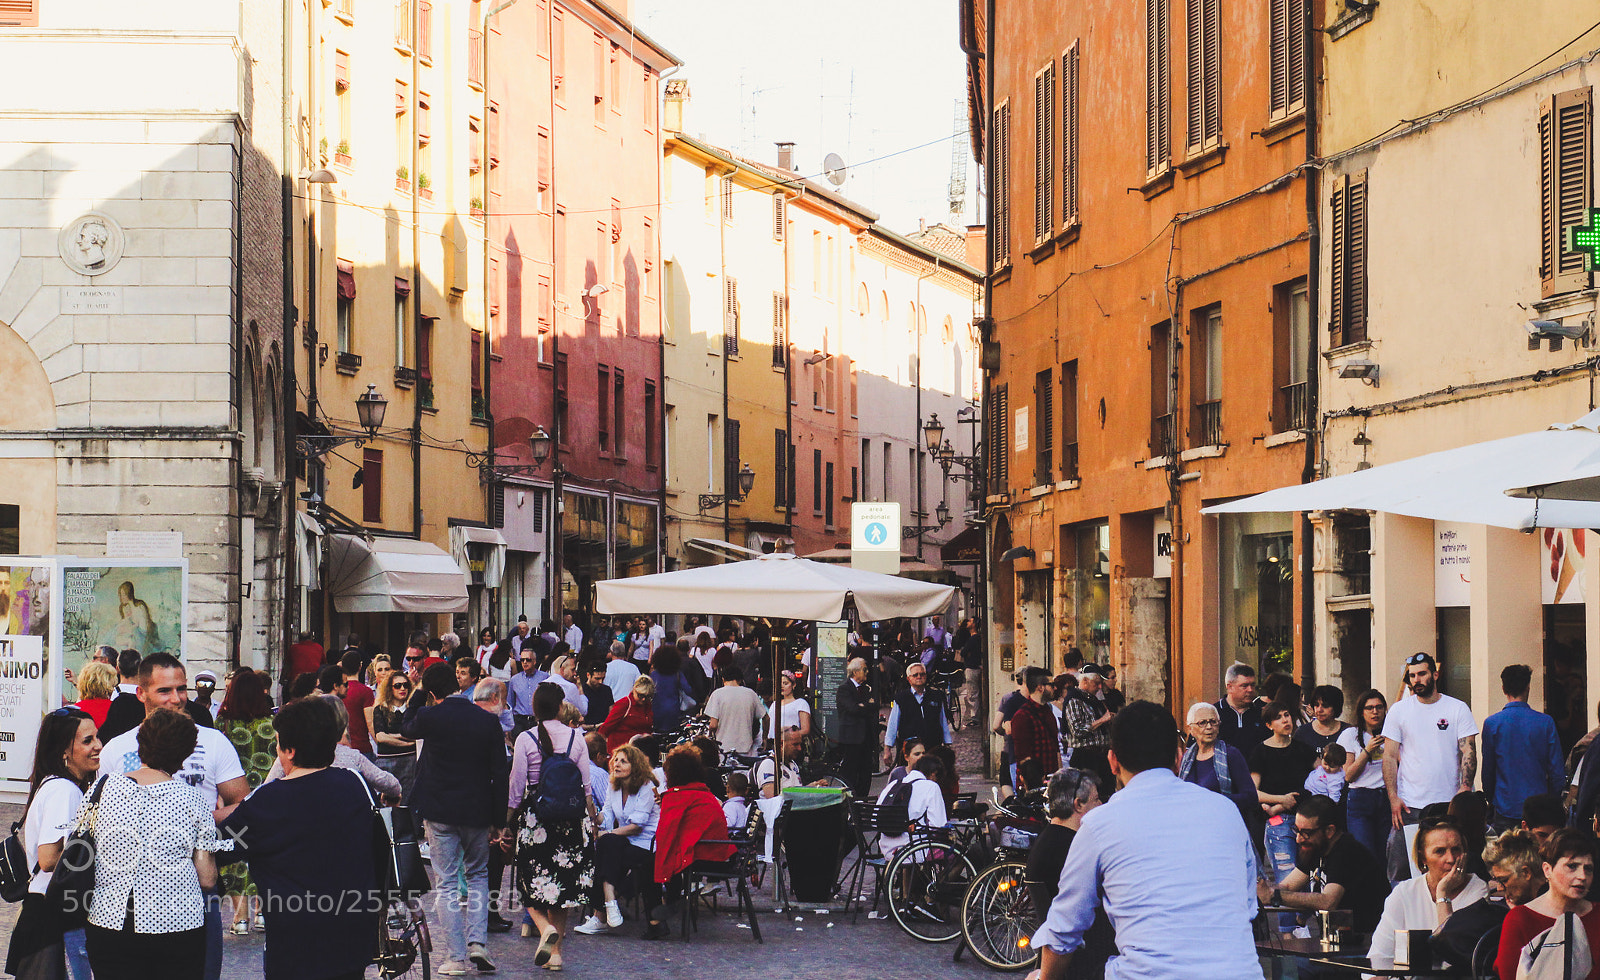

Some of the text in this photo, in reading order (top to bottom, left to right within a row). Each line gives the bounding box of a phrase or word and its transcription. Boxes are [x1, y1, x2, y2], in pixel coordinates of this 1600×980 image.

[67, 580, 93, 588] DIAMANTI
[67, 596, 95, 604] 10 GIUGNO
[0, 640, 14, 657] TI
[0, 660, 40, 680] NIMO
[0, 683, 26, 695] PSICHE
[0, 694, 22, 706] EVIATI
[0, 707, 15, 718] ONI
